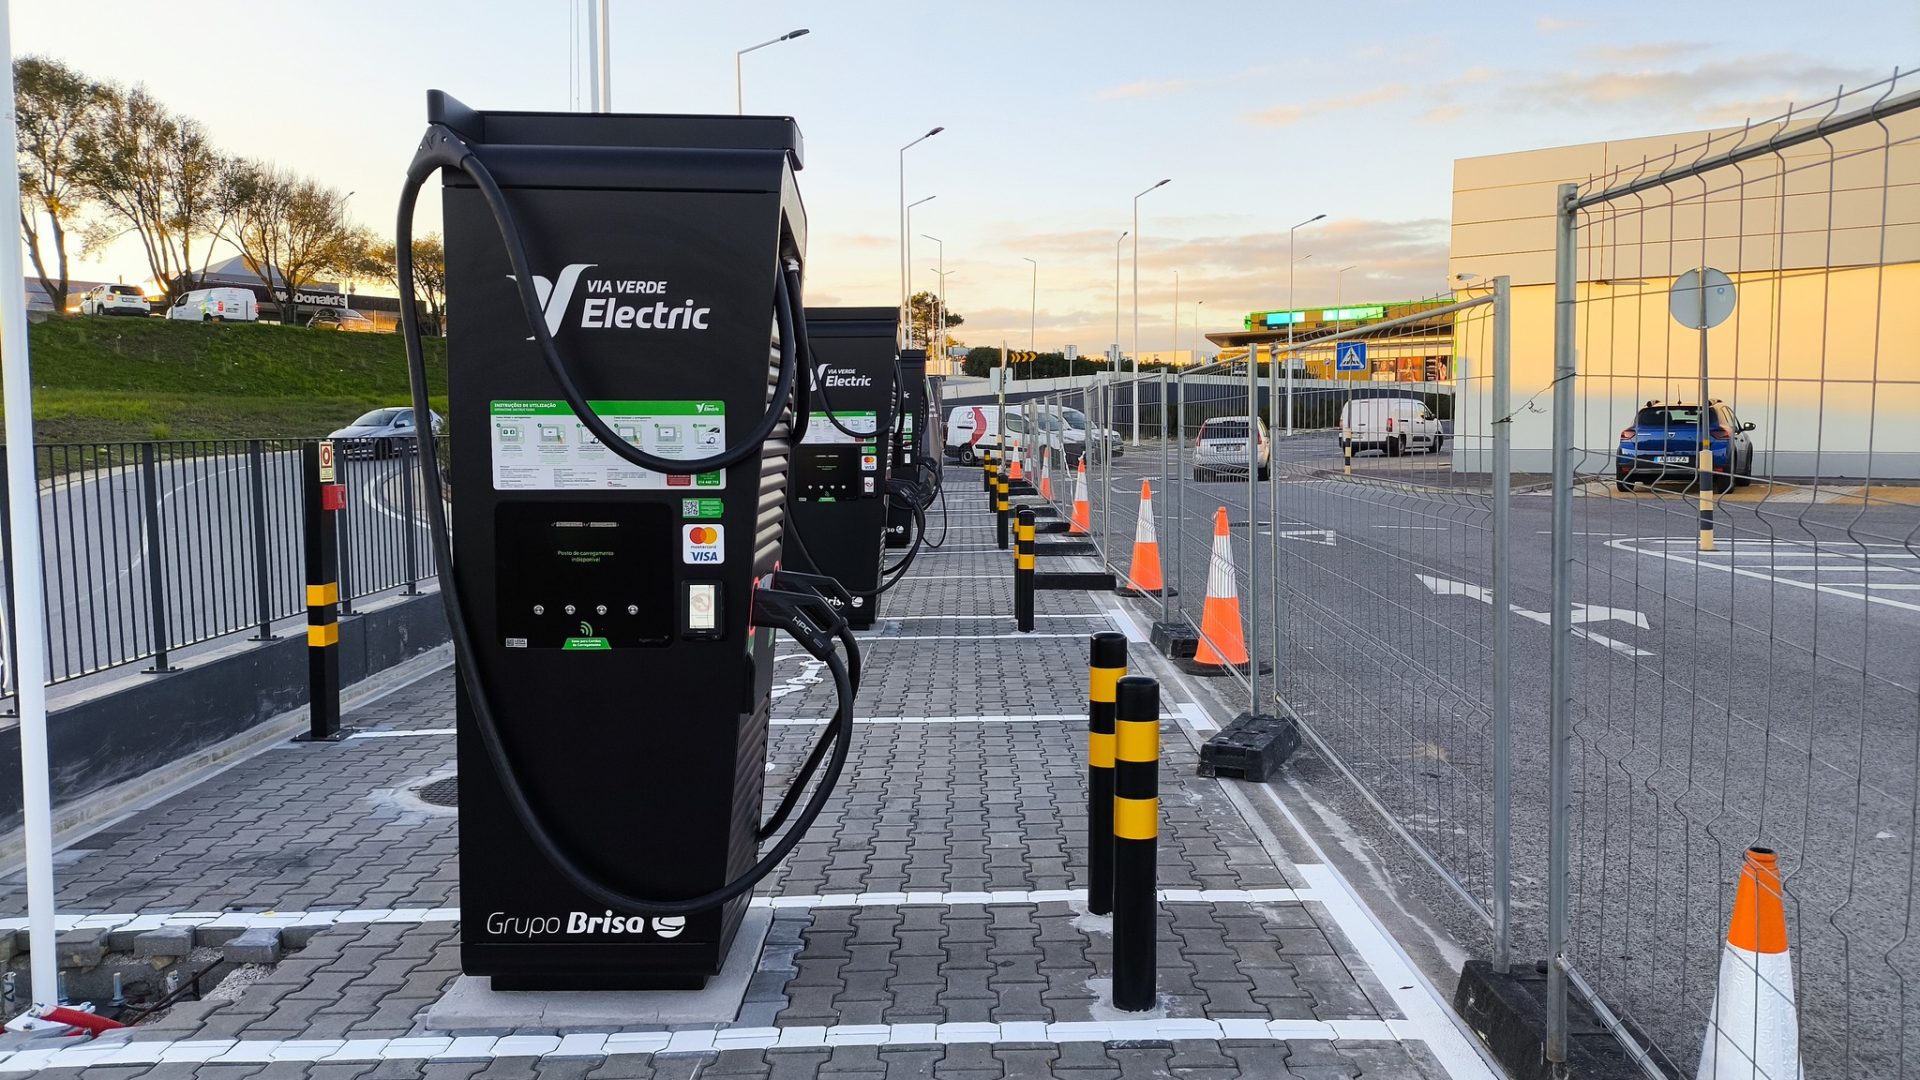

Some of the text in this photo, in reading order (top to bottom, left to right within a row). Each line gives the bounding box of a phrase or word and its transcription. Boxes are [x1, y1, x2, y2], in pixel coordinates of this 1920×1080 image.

[587, 280, 667, 294] VIA VERDE
[580, 297, 711, 330] Electric
[825, 374, 872, 387] Electric
[690, 551, 718, 561] VISA
[792, 616, 812, 634] HPC
[486, 909, 645, 938] Grupo Brisa
